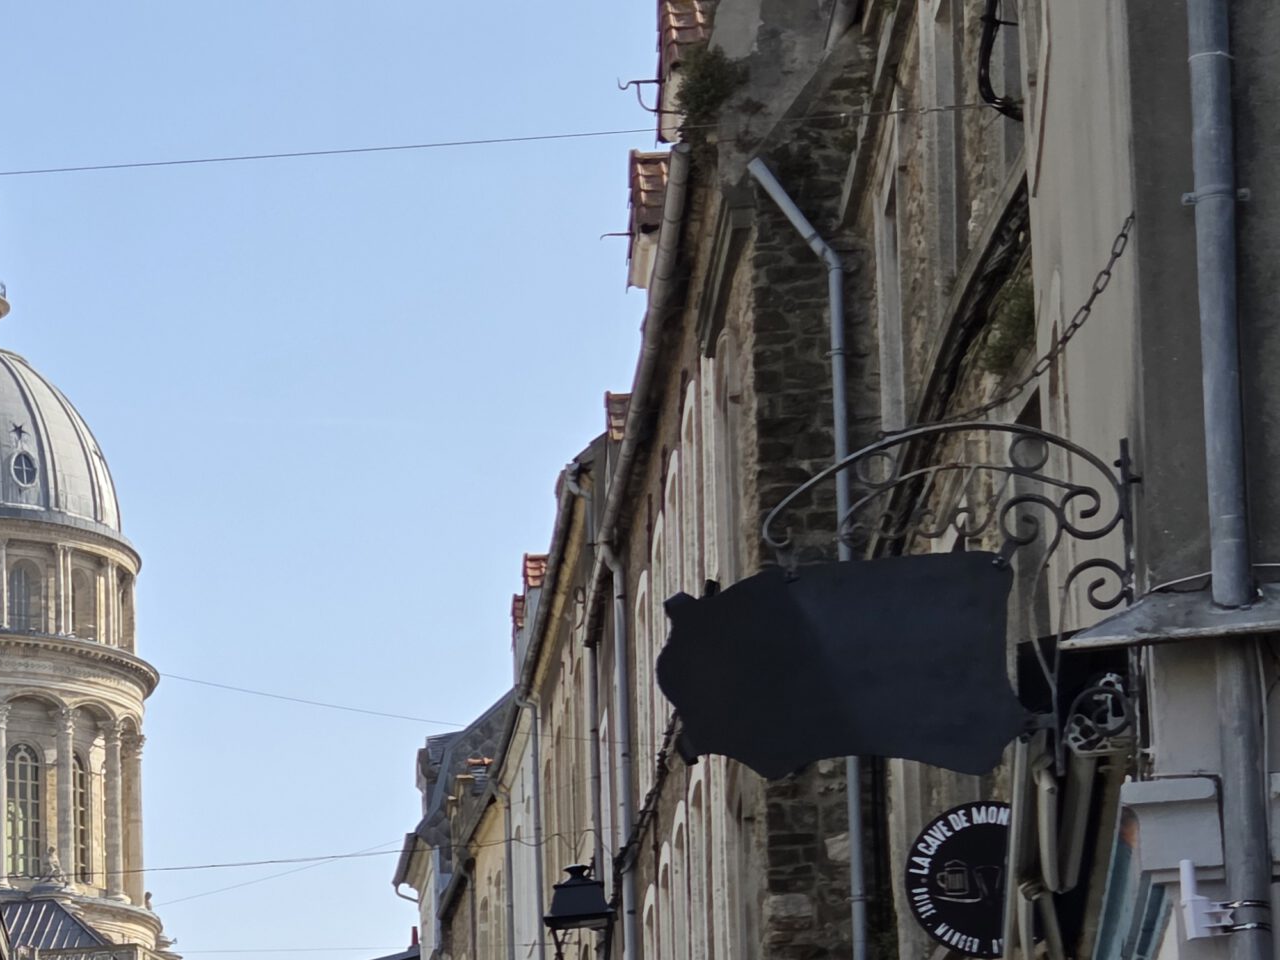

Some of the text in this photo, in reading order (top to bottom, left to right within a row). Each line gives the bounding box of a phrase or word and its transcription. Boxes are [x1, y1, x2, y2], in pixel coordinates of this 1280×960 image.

[947, 809, 971, 832] DE
[917, 820, 954, 856] CAVE
[908, 855, 933, 875] LA
